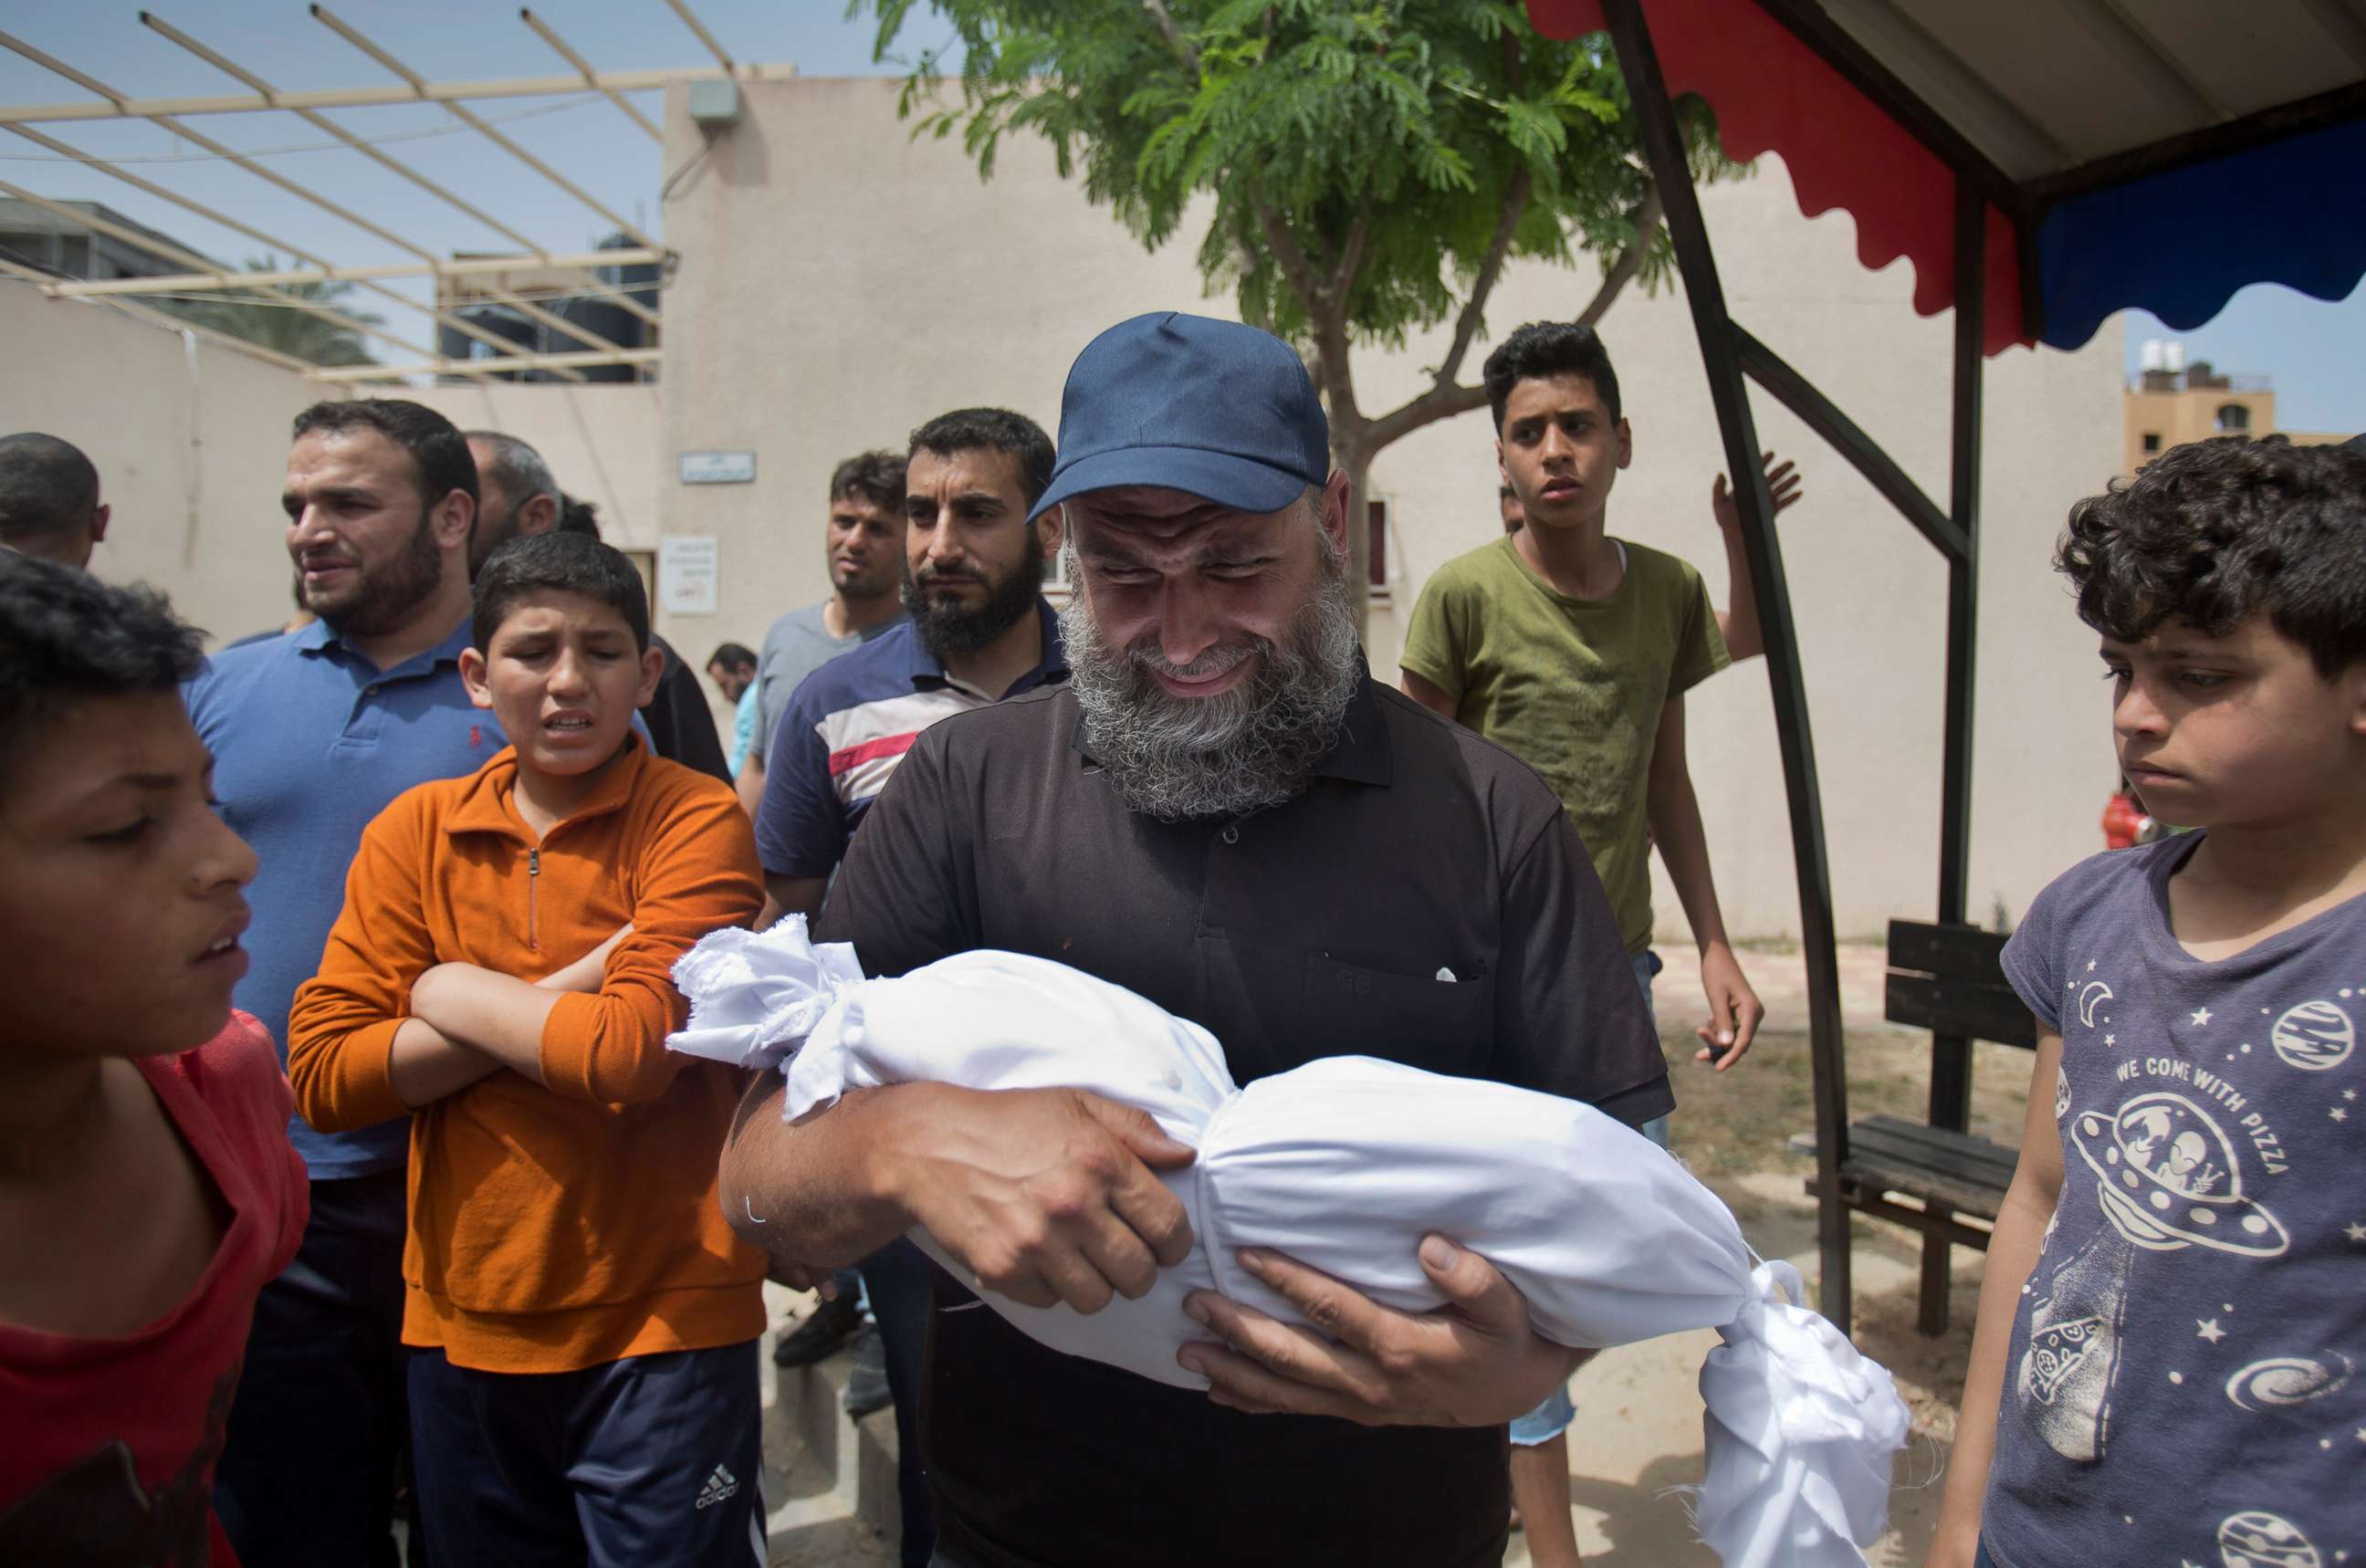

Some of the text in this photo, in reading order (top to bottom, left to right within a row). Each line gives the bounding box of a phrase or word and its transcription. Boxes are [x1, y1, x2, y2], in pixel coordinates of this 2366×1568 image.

[2117, 1057, 2289, 1175] WE COME WITH PIZZA
